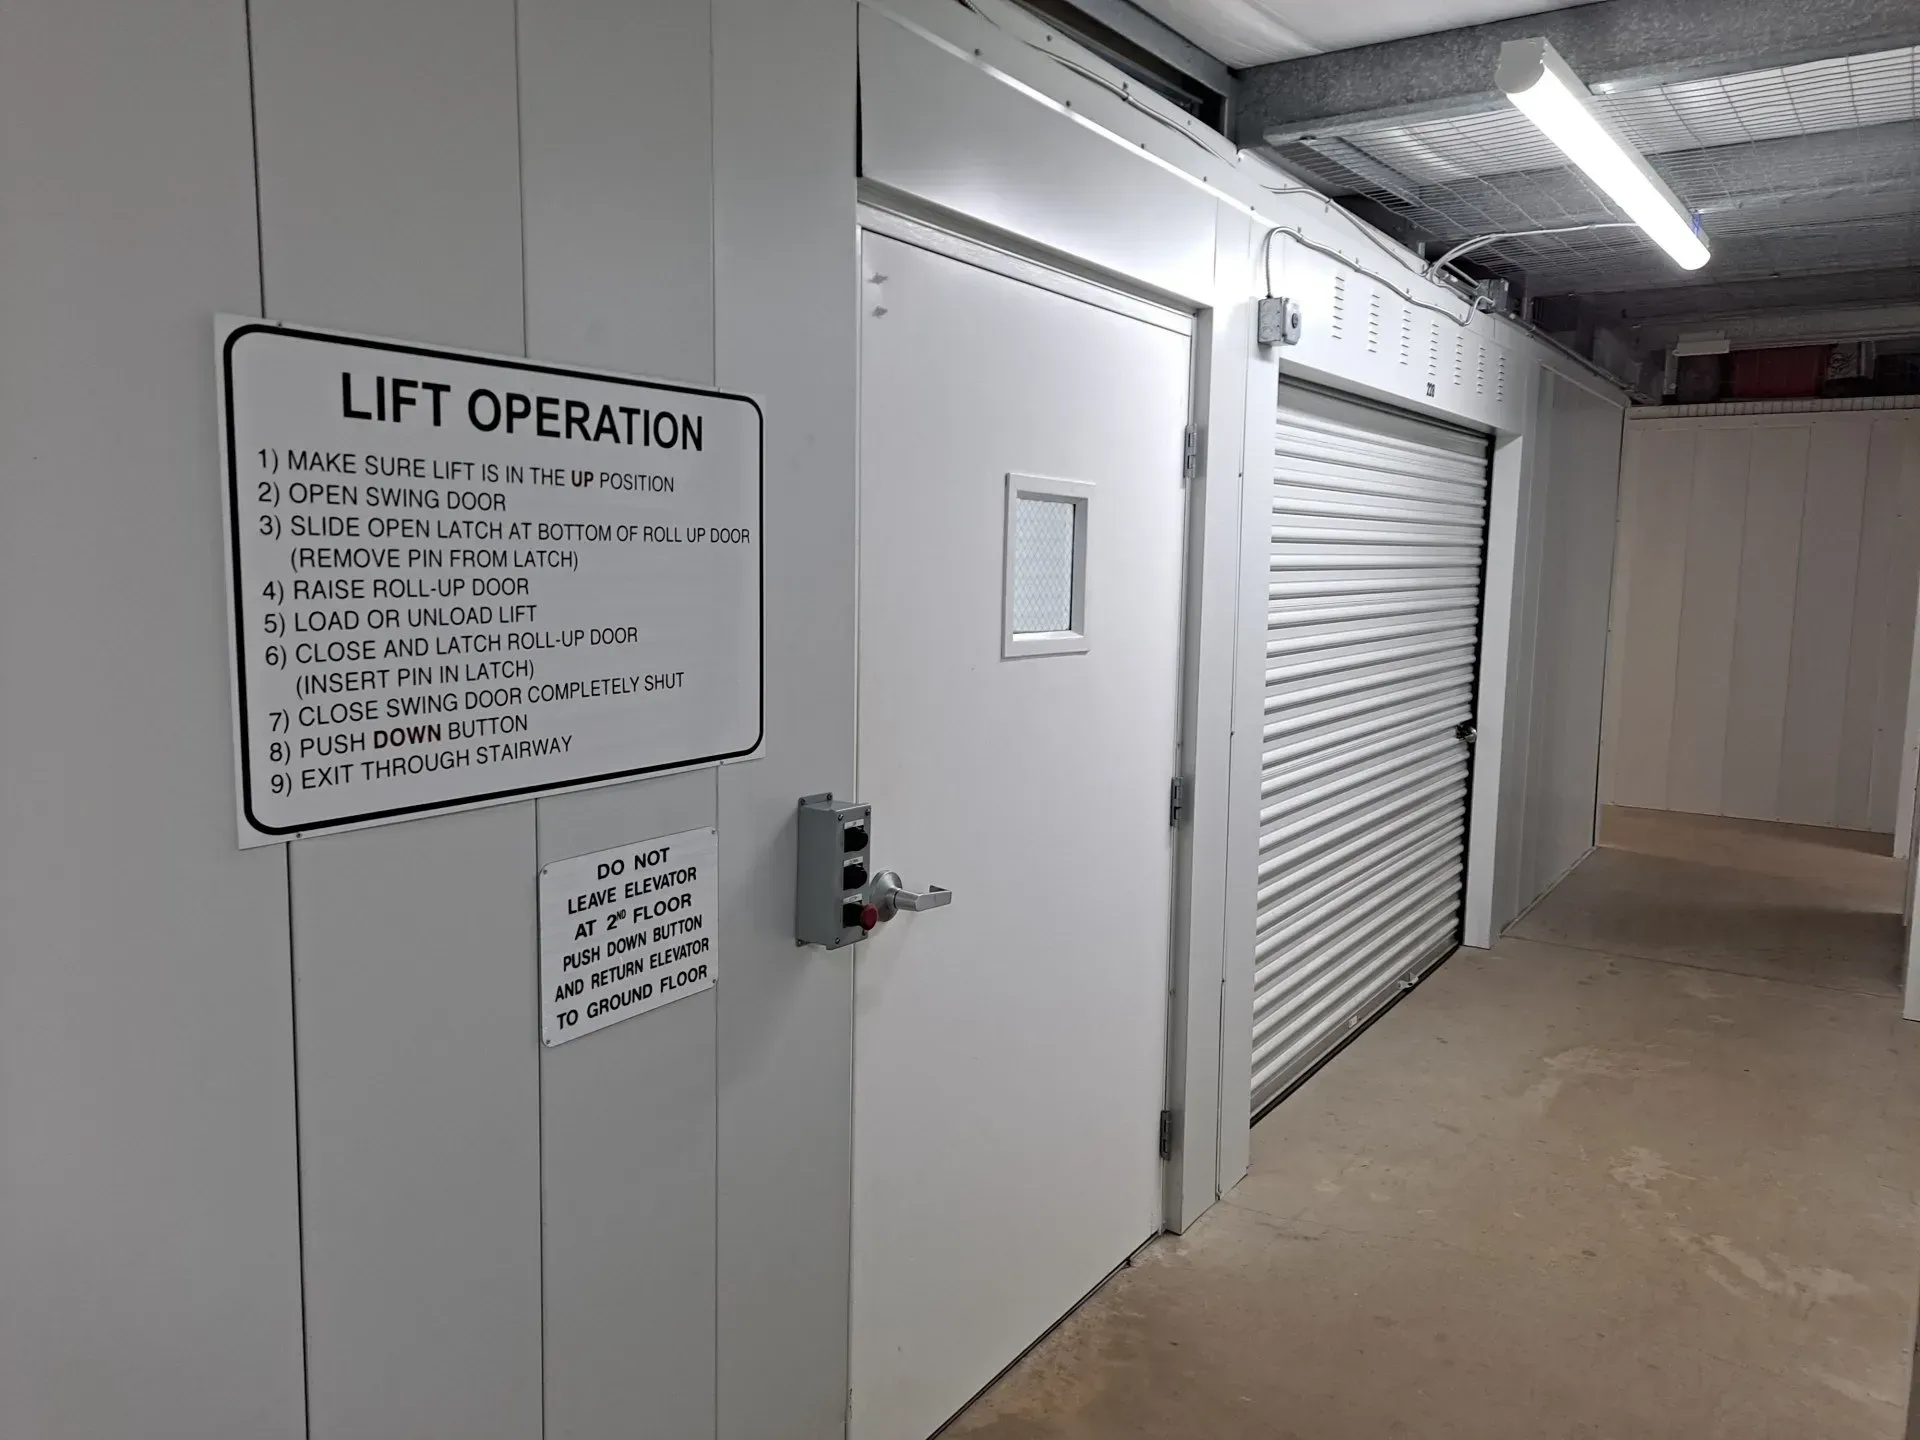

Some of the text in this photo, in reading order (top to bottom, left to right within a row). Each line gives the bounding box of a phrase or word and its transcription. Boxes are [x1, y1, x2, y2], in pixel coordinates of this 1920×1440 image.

[342, 372, 702, 451] LIFT OPERATION
[258, 448, 673, 492] 1) MAKE SURE LIFT IS IN THE UP POSITION
[258, 482, 506, 511] 2) OPEN SWING DOOR
[259, 515, 750, 543] 3) SLIDE OPEN LATCH AT BOTTOM OF ROLL UP DOOR
[291, 548, 578, 573] (REMOVE PIN FROM LATCH)
[262, 577, 529, 606] 4) RAISE ROLL-UP DOOR
[264, 605, 537, 638] 5) LOAD OR UNLOAD LIFT
[265, 627, 637, 670] 6) CLOSE AND LATCH ROLL-UP DOOR
[296, 659, 534, 700] (INSERT PIN IN LATCH)
[269, 672, 684, 734] 7) CLOSE SWING DOOR COMPLETELY SHUT
[270, 714, 527, 766] 8) PUSH DOWN BUTTON
[271, 735, 572, 797] 9) EXIT THROUGH STAIRWAY
[597, 847, 670, 881] DO NOT
[568, 867, 696, 915] LEAVE ELEVATOR
[575, 919, 597, 941] AT
[633, 893, 692, 924] FLOOR
[563, 914, 702, 972] PUSH DOWN BUTTON
[555, 937, 709, 1002] AND RETURN ELEVATOR
[556, 964, 707, 1030] TO GROUND FLOOR
